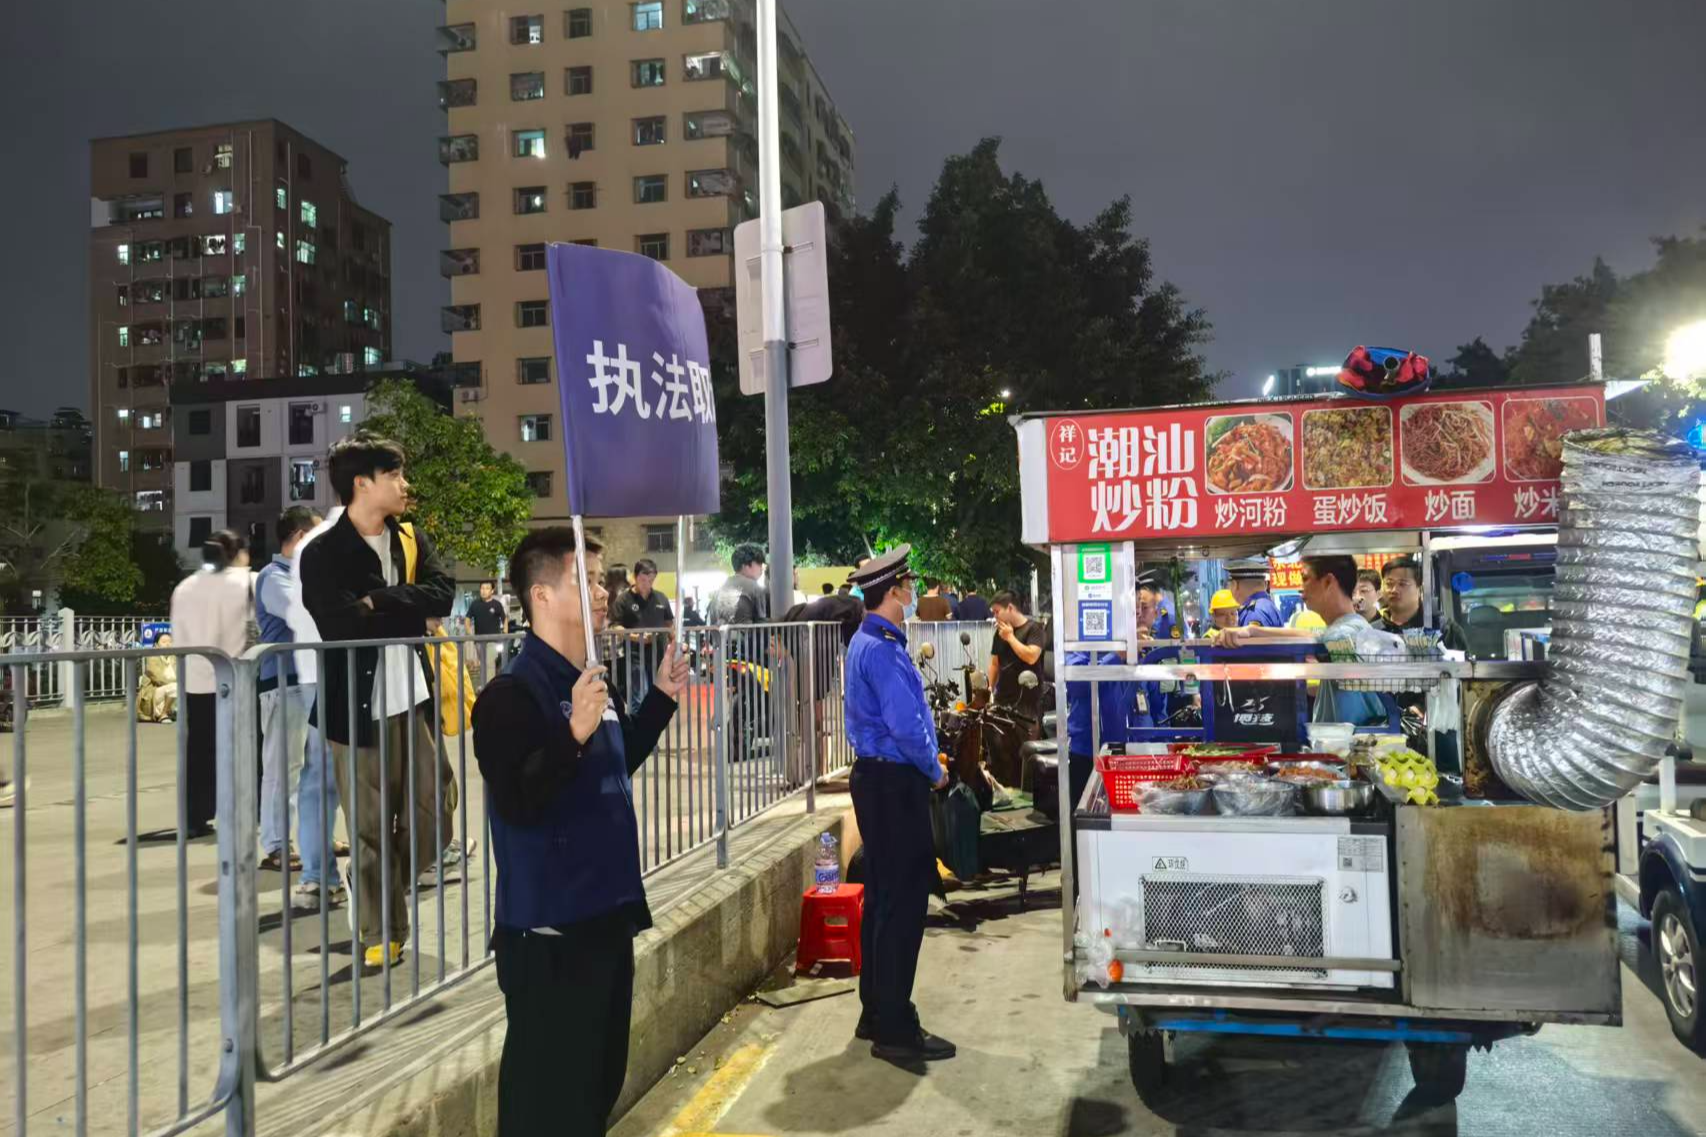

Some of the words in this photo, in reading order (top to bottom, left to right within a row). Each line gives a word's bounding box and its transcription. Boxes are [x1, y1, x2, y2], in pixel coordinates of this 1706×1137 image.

[1059, 424, 1077, 463] 祥记
[1087, 423, 1195, 479] 潮汕
[1091, 476, 1199, 533] 炒粉
[1215, 496, 1288, 529] 炒河粉
[1312, 493, 1388, 526] 蛋炒饭
[1424, 489, 1476, 522] 炒面
[1513, 486, 1560, 519] 炒米
